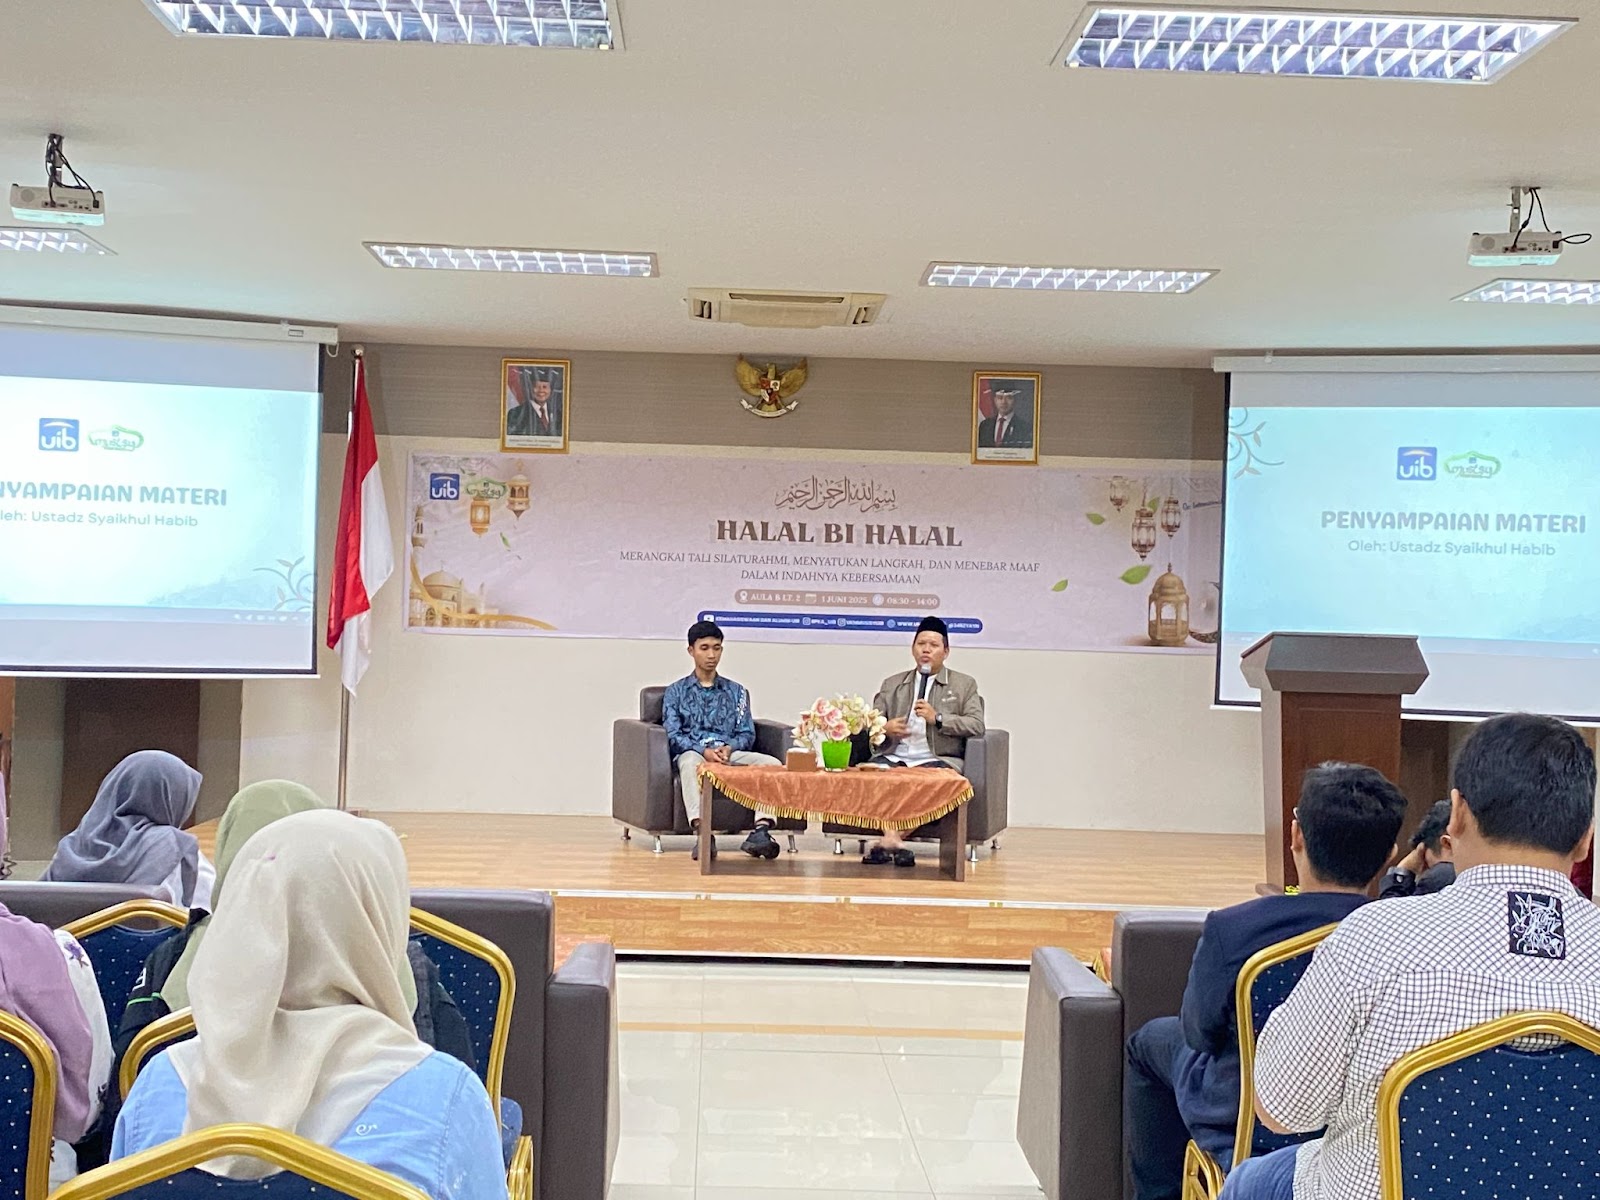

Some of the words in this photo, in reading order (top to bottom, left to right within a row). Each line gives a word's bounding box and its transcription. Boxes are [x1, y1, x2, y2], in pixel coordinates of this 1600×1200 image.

[41, 428, 77, 450] uib
[1400, 456, 1434, 478] uib
[139, 486, 227, 506] MATERI
[431, 480, 458, 498] uib
[31, 510, 84, 523] Ustadz
[88, 512, 151, 526] Syaikhul
[154, 514, 198, 527] Habib
[1321, 510, 1490, 531] PENYAMPAIAN
[1495, 513, 1586, 534] MATERI
[717, 519, 815, 543] HALAL
[824, 523, 854, 544] BI
[865, 524, 963, 547] HALAL
[1348, 540, 1386, 552] Oleh:
[1389, 541, 1441, 553] Ustadz
[1445, 542, 1507, 557] Syaikhul
[1511, 543, 1556, 556] Habib
[619, 551, 685, 562] MERANGKAI
[688, 553, 711, 563] TALI
[714, 554, 790, 565] SILATURAHMI,
[793, 556, 869, 567] MENYATUKAN
[871, 558, 926, 570] LANGKAH,
[928, 560, 951, 569] DAN
[954, 560, 1007, 571] MENEBAR
[1009, 562, 1041, 572] MAAF
[741, 570, 779, 580] DALAM
[782, 571, 839, 582] INDAHNYA
[841, 573, 921, 584] KEBERSAMAAN
[750, 593, 773, 601] AULA
[848, 596, 868, 604] 2025
